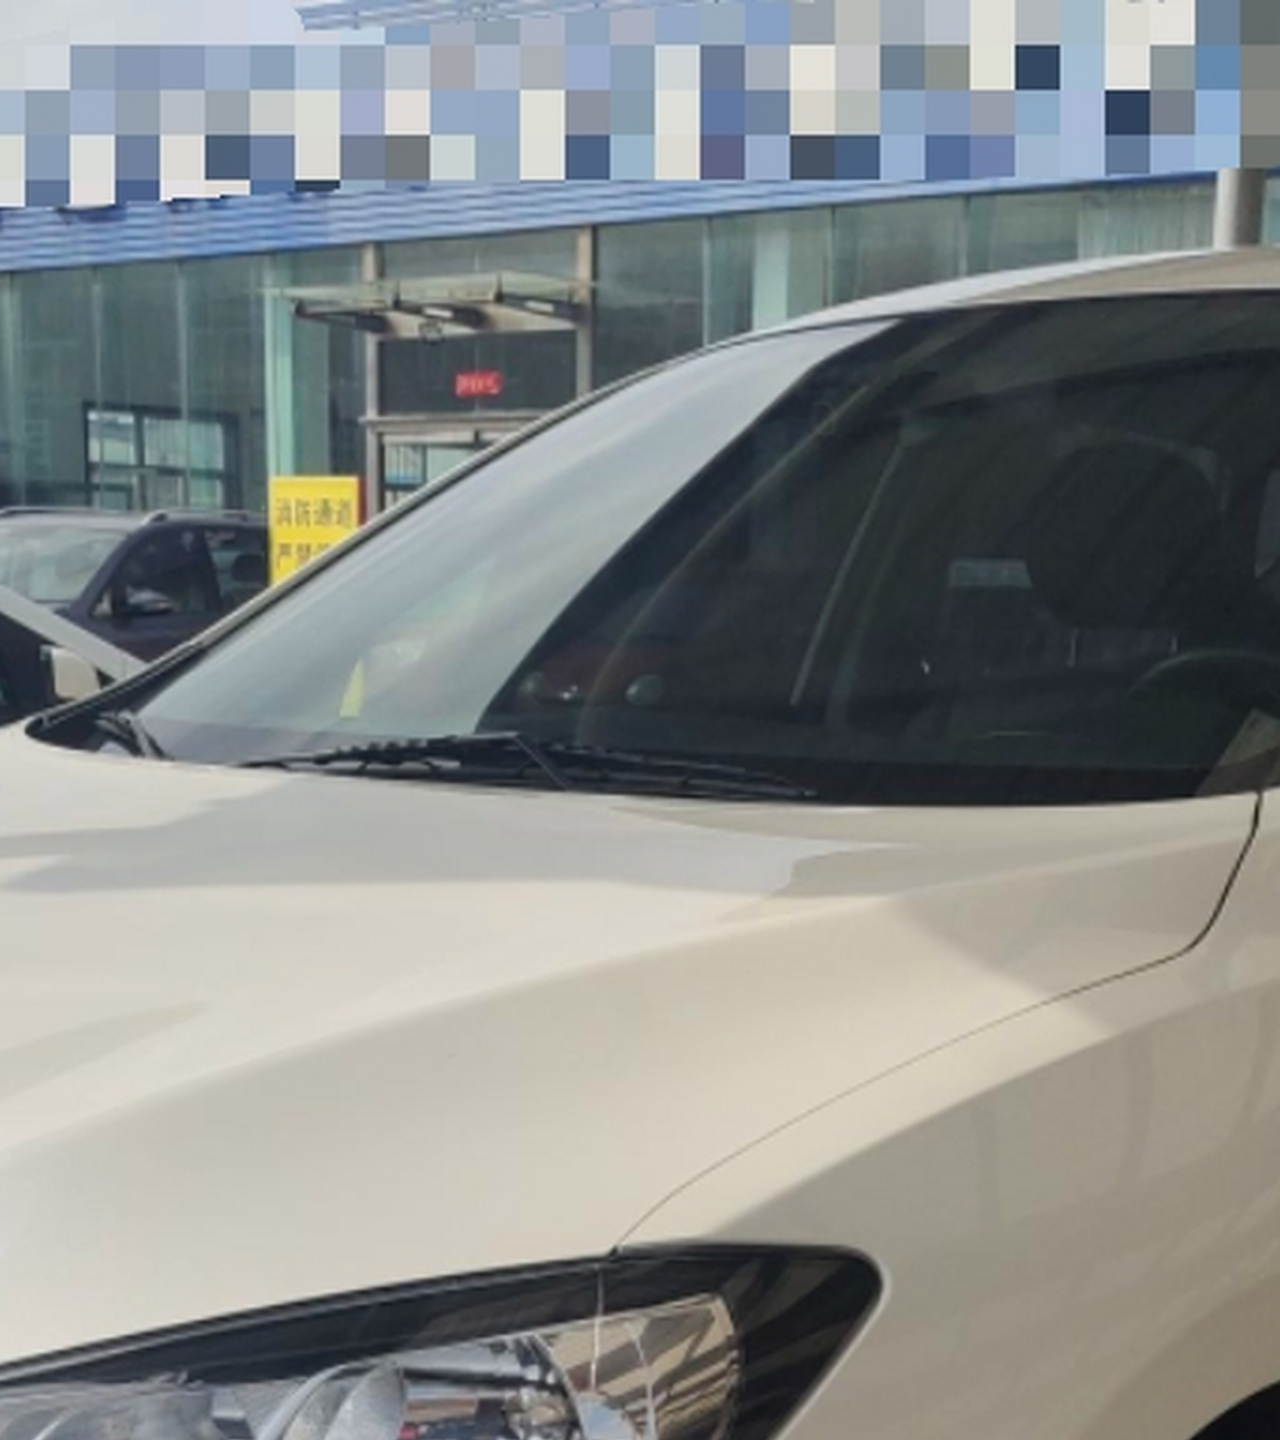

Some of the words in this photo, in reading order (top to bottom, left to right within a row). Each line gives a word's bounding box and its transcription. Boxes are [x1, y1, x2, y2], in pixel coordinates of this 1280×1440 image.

[275, 498, 352, 527] 消防通道
[276, 542, 331, 572] 严禁
